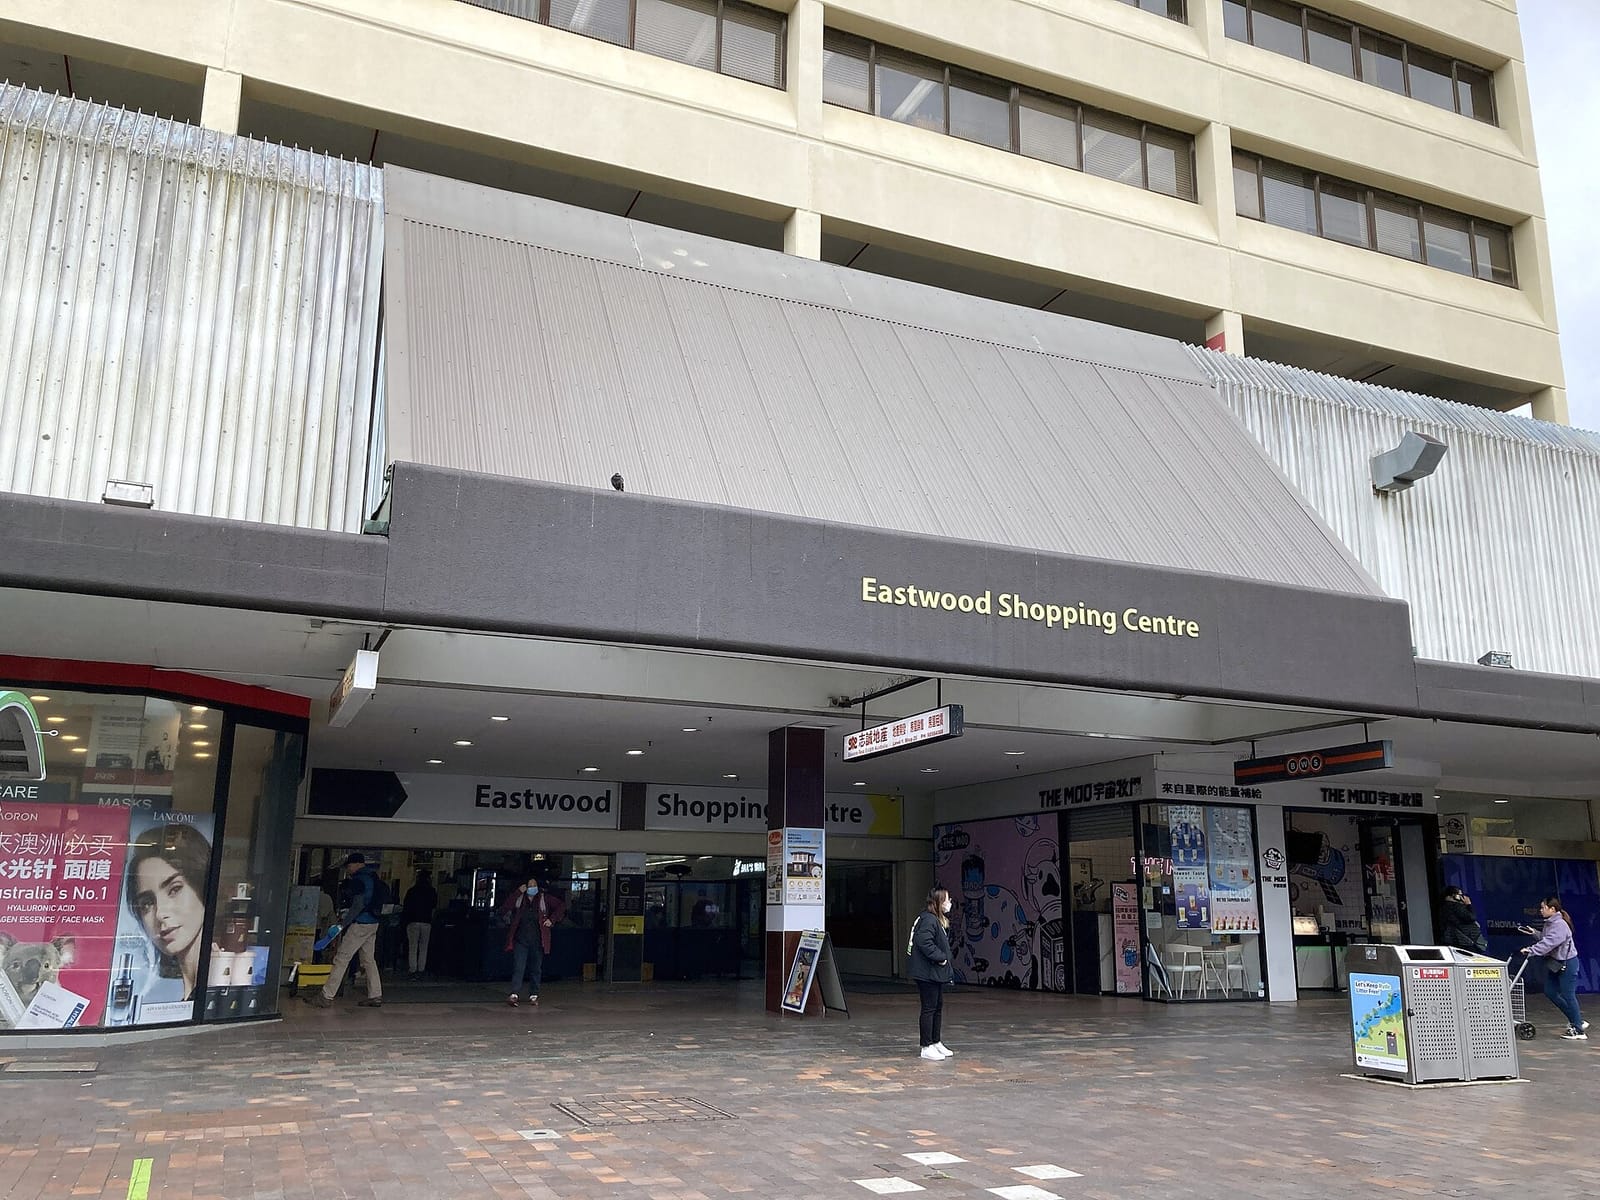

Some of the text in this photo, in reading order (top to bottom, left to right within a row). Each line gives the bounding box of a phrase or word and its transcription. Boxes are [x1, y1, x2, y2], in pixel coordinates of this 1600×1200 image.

[862, 577, 1200, 638] Eastwood Shopping Centre
[1289, 757, 1321, 772] BWS
[475, 784, 611, 813] Eastwood
[1039, 783, 1093, 808] THE MOO
[1162, 783, 1262, 799] 來自星際的能量補給
[1320, 787, 1377, 805] THE MOO
[98, 798, 153, 810] MASKS
[1510, 845, 1535, 856] 160
[63, 859, 112, 880] 面膜
[73, 886, 107, 900] No.1
[620, 881, 630, 894] G
[7, 904, 76, 912] HYALURONIC ACID
[19, 915, 55, 923] ESSENCE
[61, 915, 81, 923] FACE
[82, 915, 105, 923] MASK
